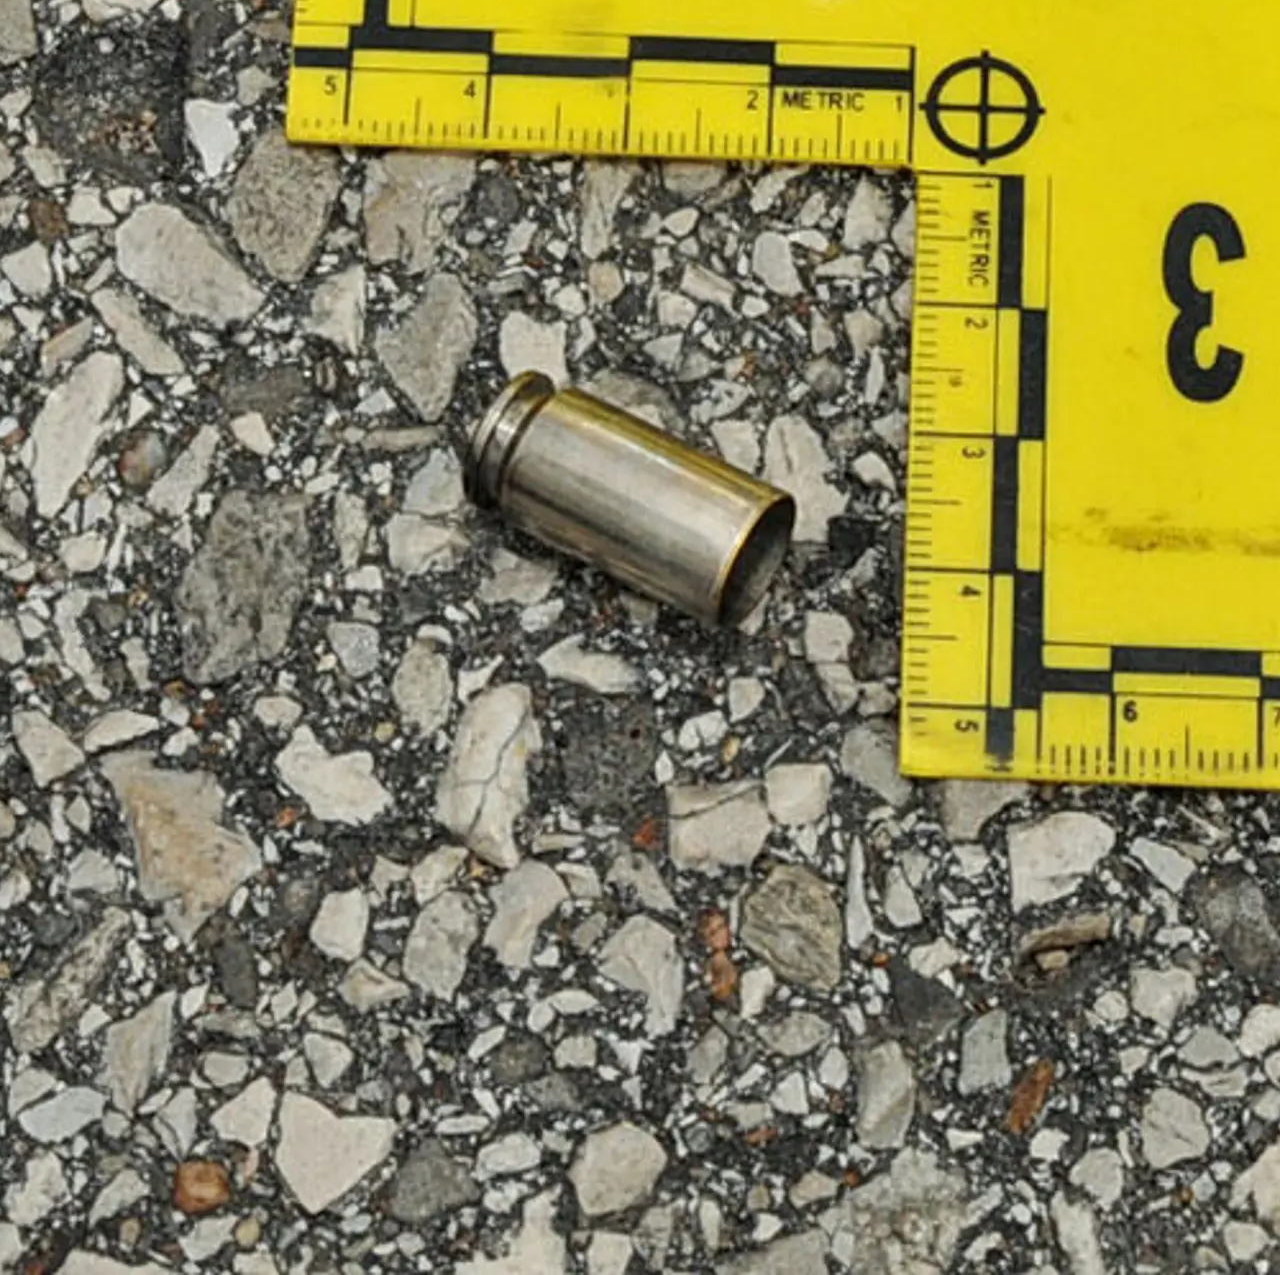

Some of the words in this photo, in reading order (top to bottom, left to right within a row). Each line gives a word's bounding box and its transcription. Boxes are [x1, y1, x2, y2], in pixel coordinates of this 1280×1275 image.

[323, 74, 337, 95] 5
[463, 78, 477, 99] 4
[746, 89, 758, 110] 2
[782, 90, 865, 111] METRIC
[968, 210, 991, 288] METRIC
[1161, 202, 1247, 404] 3
[964, 316, 989, 330] 2
[961, 447, 986, 459] 3
[959, 583, 982, 598] 4
[1124, 700, 1138, 724] 6
[954, 718, 980, 734] 5
